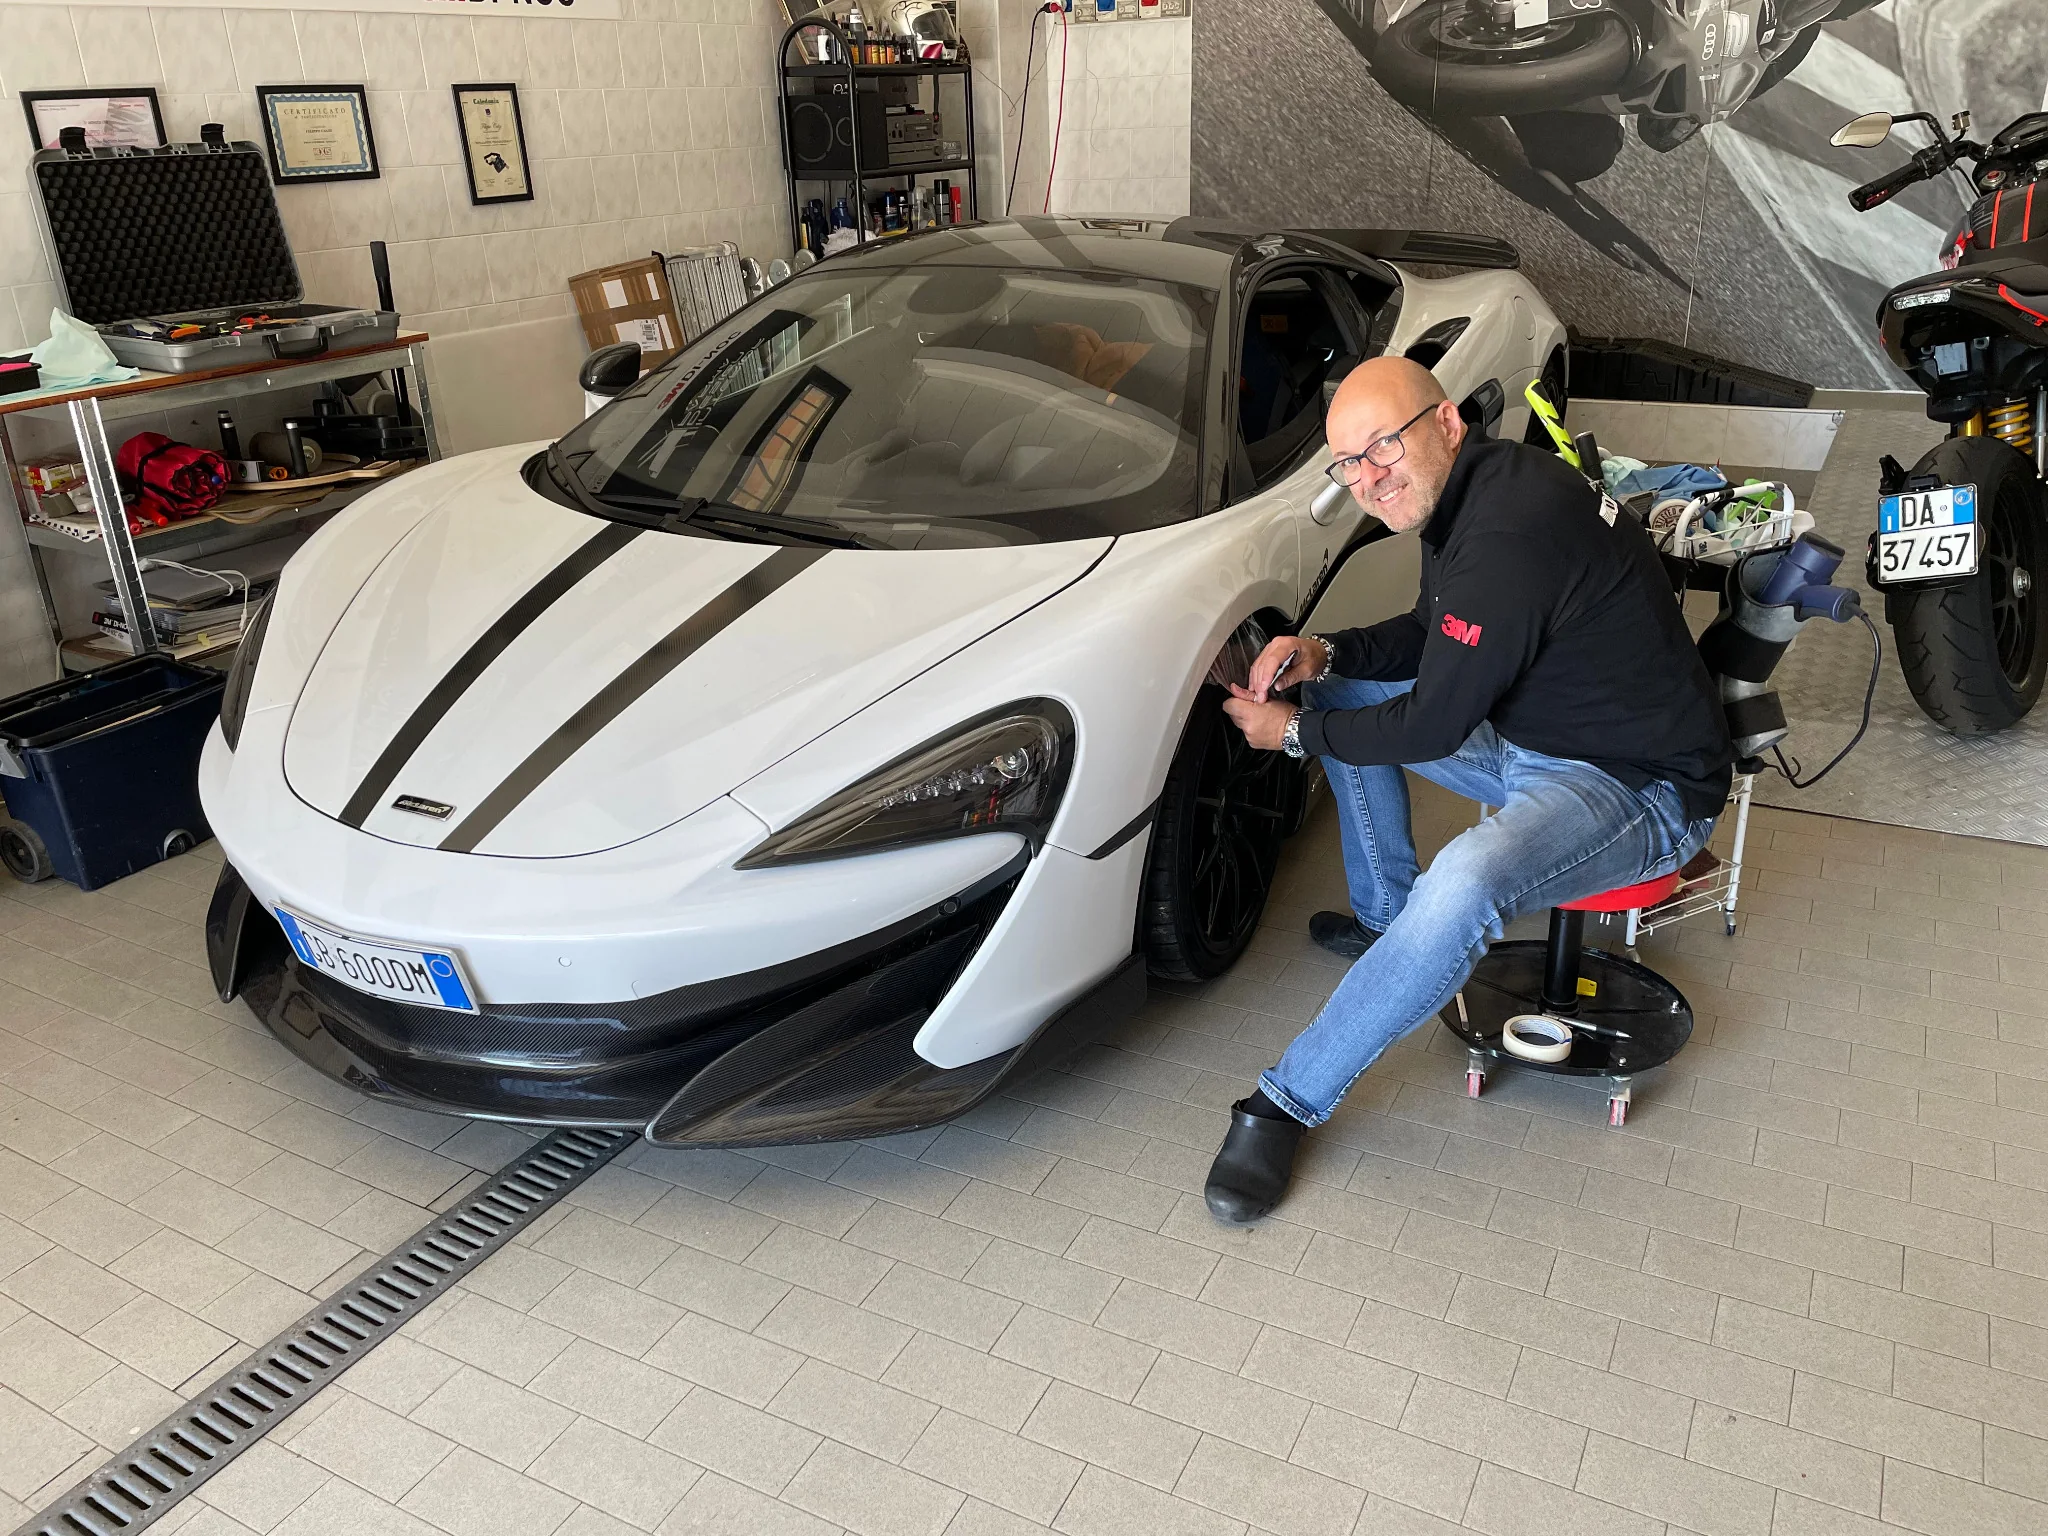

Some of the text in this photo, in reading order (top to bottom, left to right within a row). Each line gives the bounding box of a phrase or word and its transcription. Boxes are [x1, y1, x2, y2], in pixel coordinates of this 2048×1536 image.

[283, 107, 346, 116] CERTIFICATO
[1901, 494, 1935, 528] DA
[1883, 532, 1971, 572] 37457
[1441, 613, 1483, 647] 3M
[398, 799, 443, 814] McLaren
